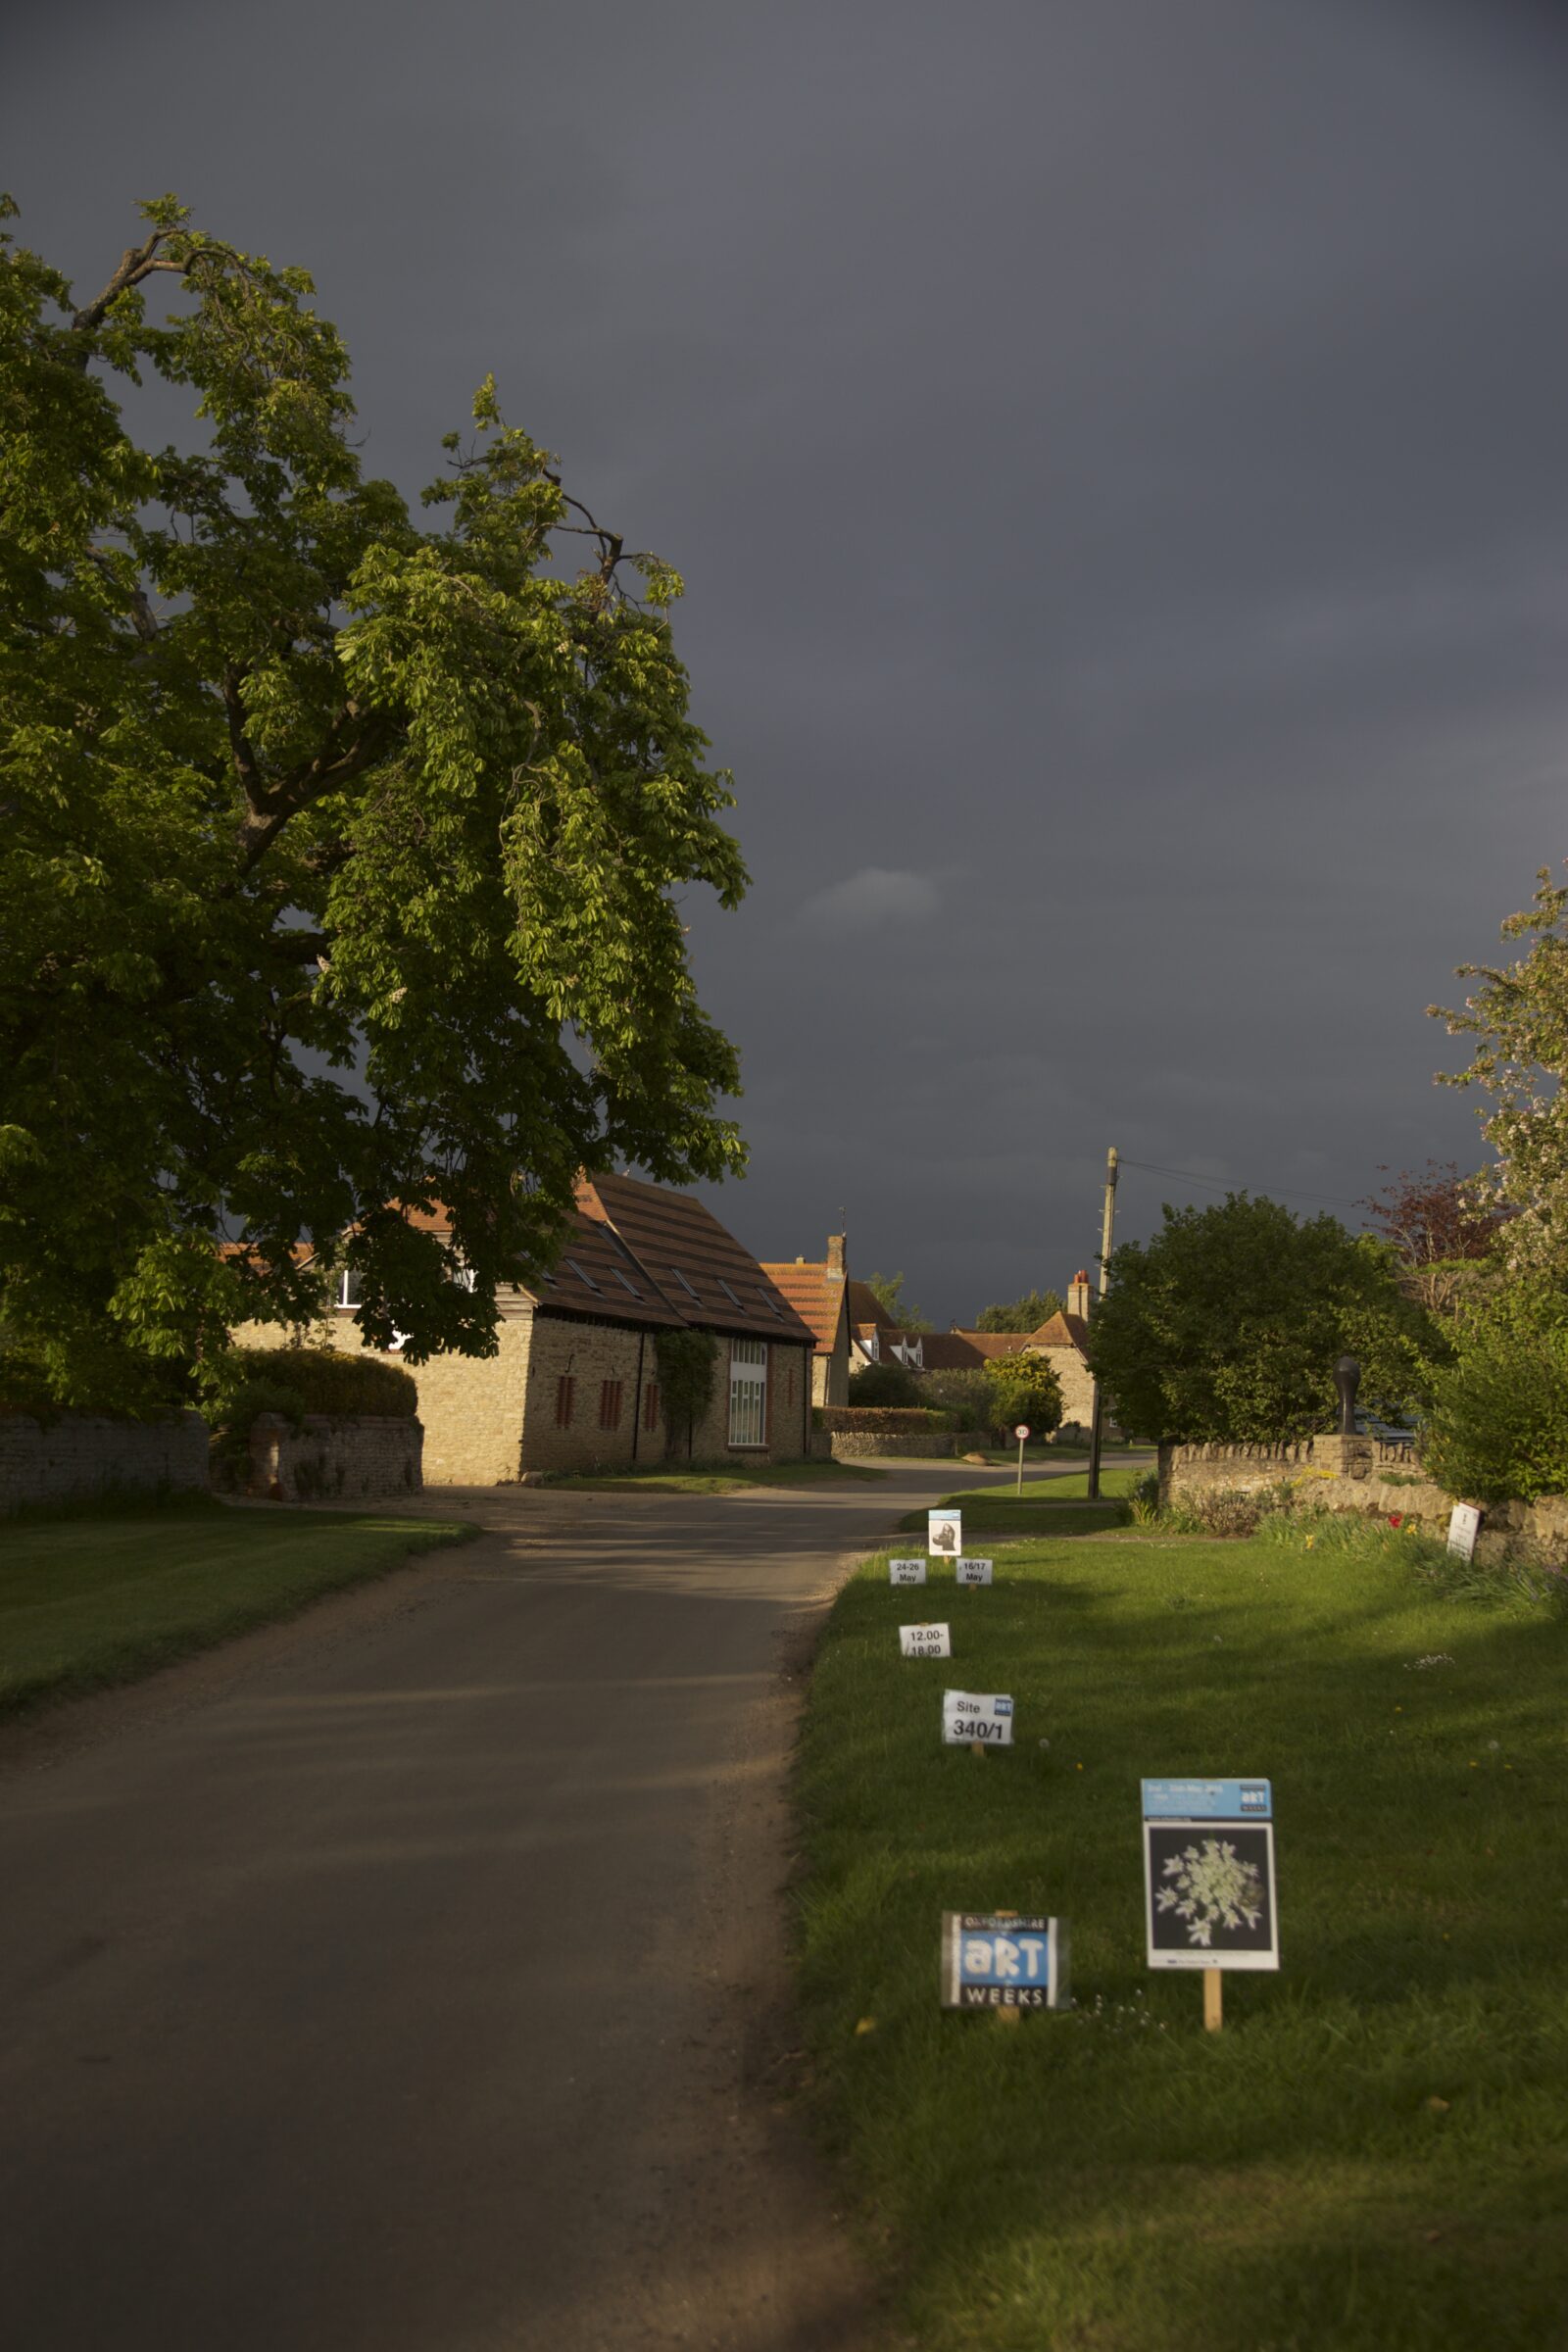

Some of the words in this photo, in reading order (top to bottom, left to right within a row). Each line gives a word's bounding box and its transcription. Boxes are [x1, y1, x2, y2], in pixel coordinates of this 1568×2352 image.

[897, 1562, 919, 1571] 24-26
[963, 1562, 986, 1571] 16/17
[900, 1573, 916, 1582] May
[965, 1573, 984, 1582] May
[910, 1630, 945, 1642] 12.00-
[911, 1644, 941, 1655] 18.00
[956, 1700, 981, 1713] Site
[954, 1719, 1003, 1740] 340/1
[965, 1986, 1044, 2006] WEEKS
